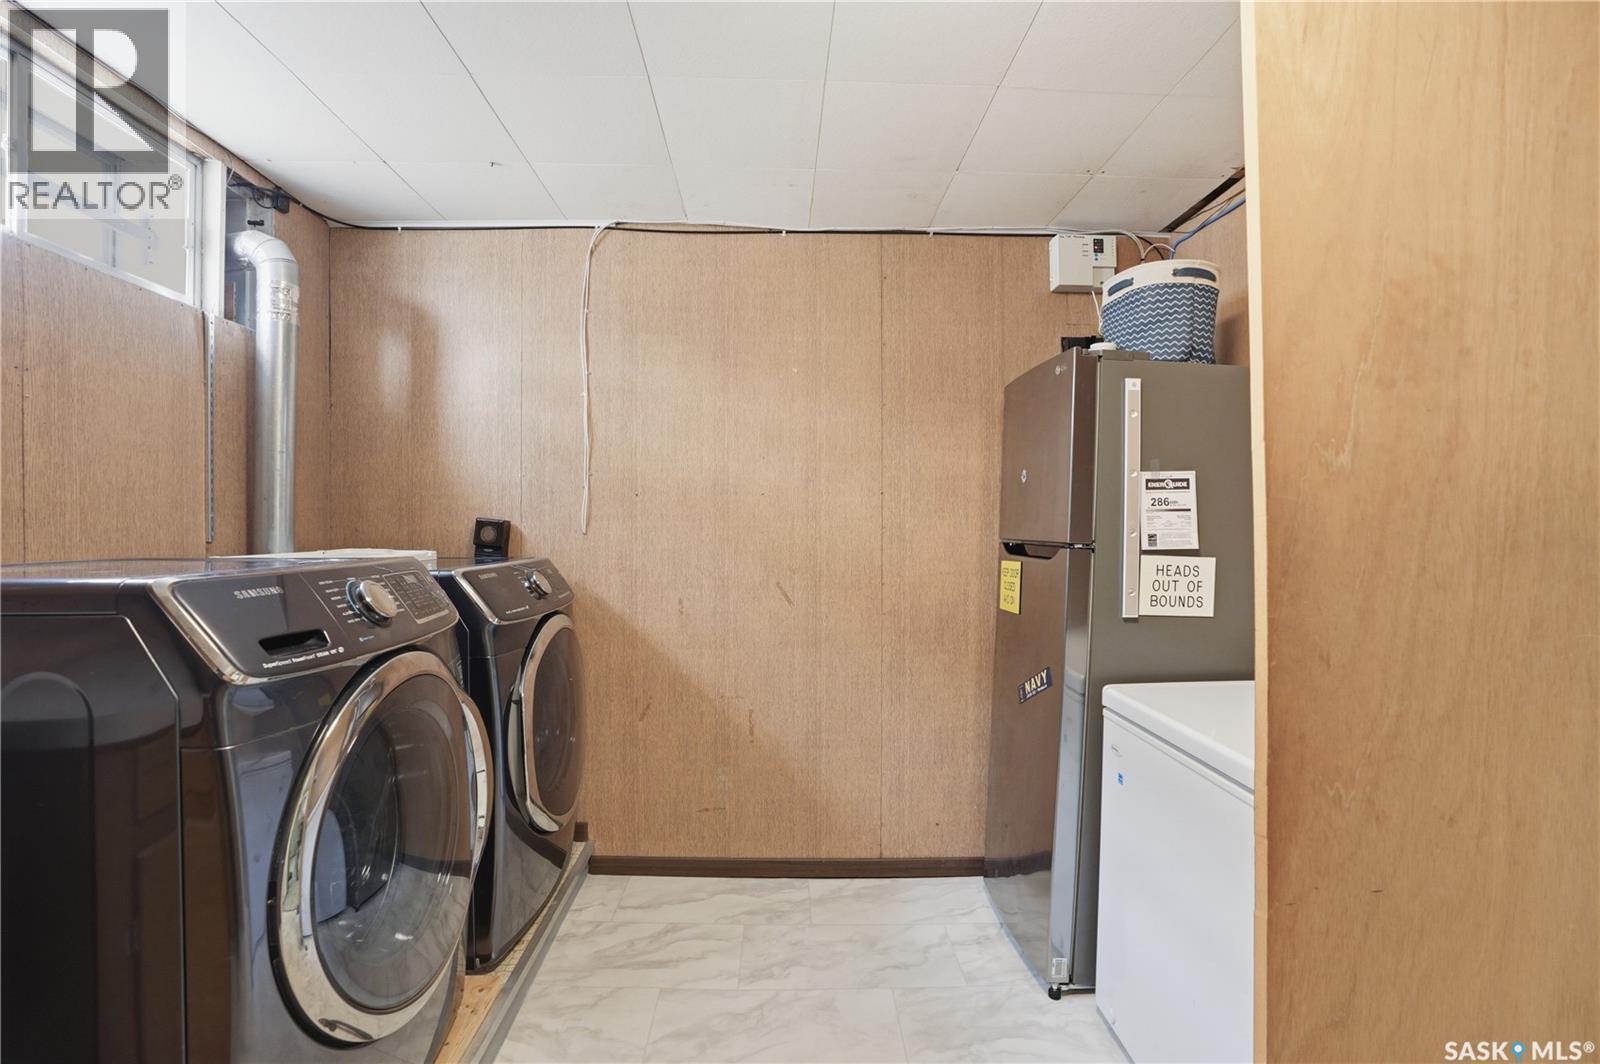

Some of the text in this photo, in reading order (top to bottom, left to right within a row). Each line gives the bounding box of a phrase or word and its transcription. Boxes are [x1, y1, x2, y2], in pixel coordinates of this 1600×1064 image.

[1150, 497, 1170, 507] 286
[1155, 564, 1200, 577] HEADS
[233, 585, 284, 599] SAMSUNG
[1152, 580, 1203, 593] OUT OF
[1150, 595, 1204, 608] BOUNDS
[1024, 669, 1047, 694] NAVY
